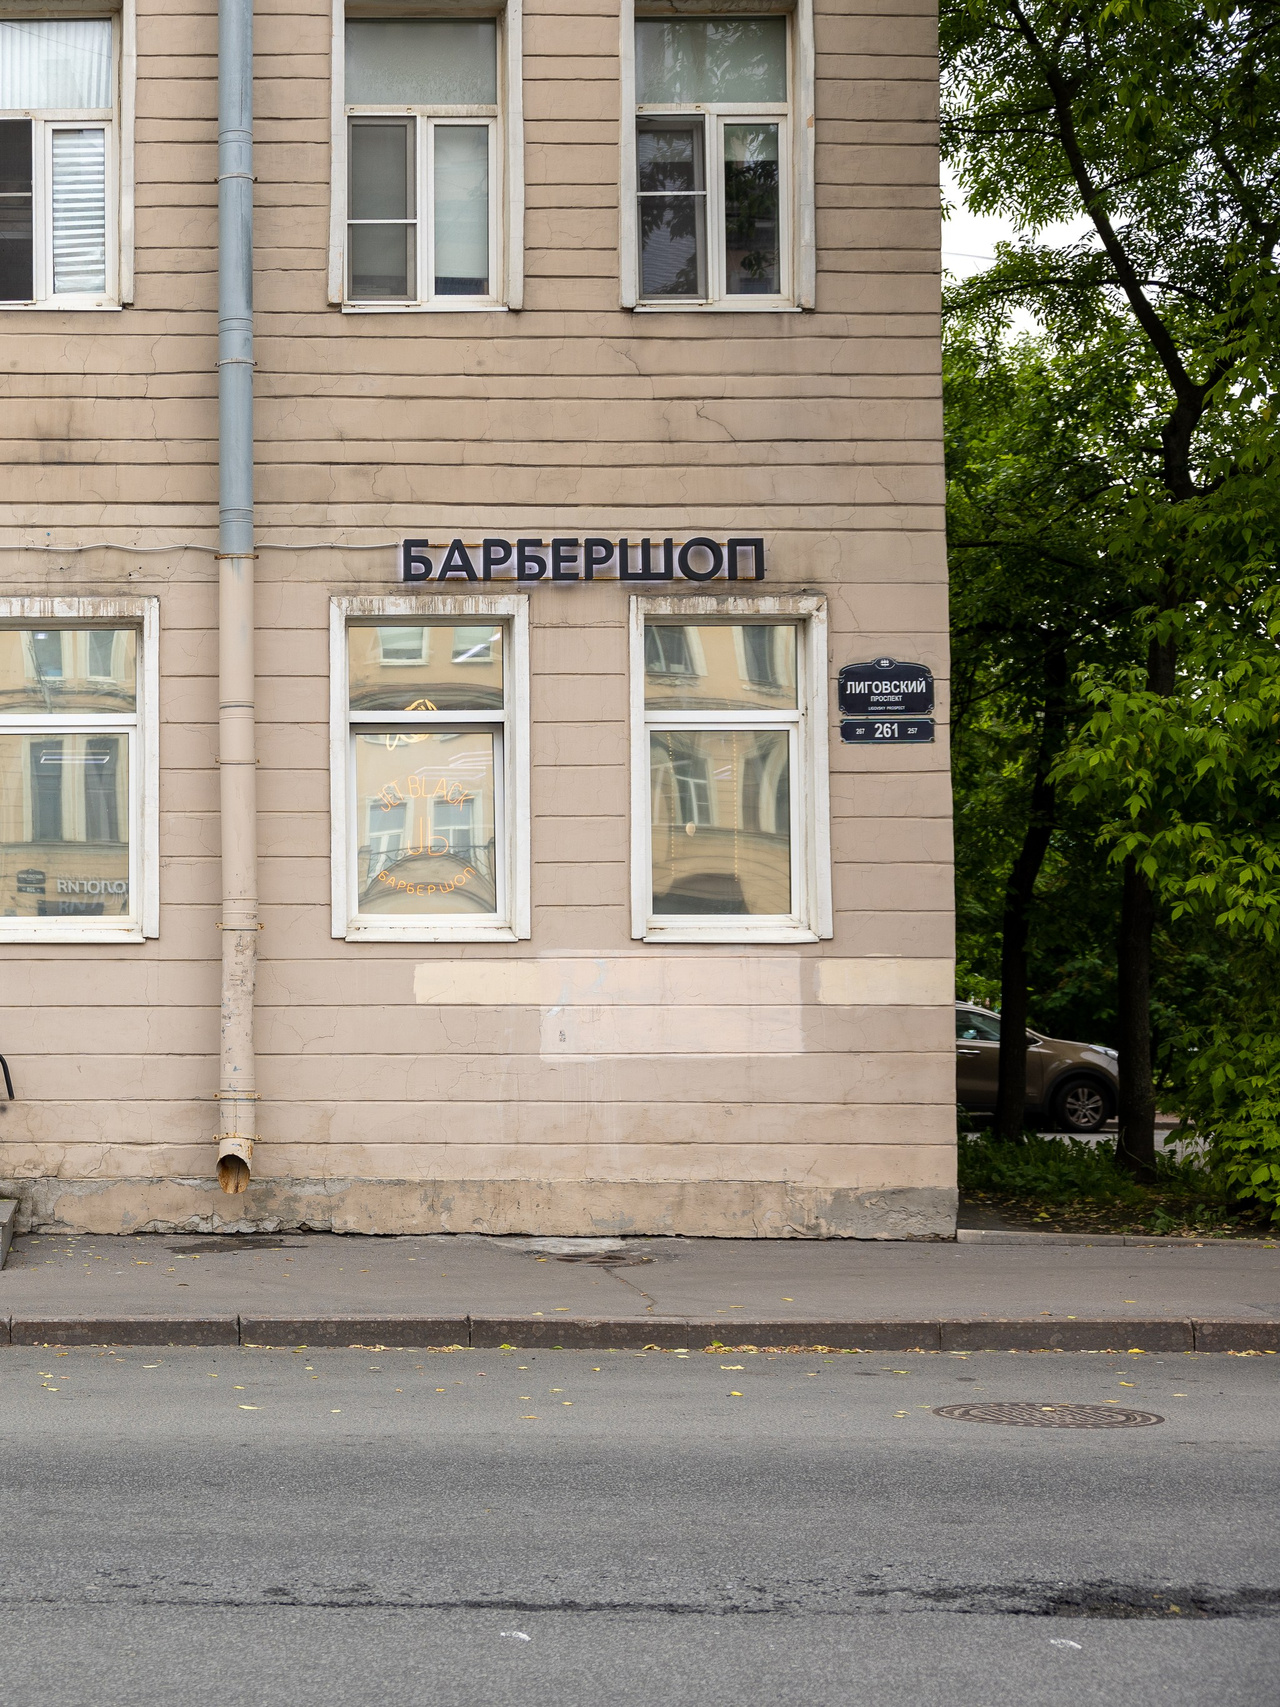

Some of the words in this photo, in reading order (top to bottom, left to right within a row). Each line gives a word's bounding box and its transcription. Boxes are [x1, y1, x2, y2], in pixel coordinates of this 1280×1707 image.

[403, 538, 764, 581] БАРБЕРШОП
[846, 678, 926, 694] ЛИГОВСКИЙ
[874, 723, 899, 738] 261
[377, 779, 405, 812] JET
[407, 775, 476, 811] BLACK
